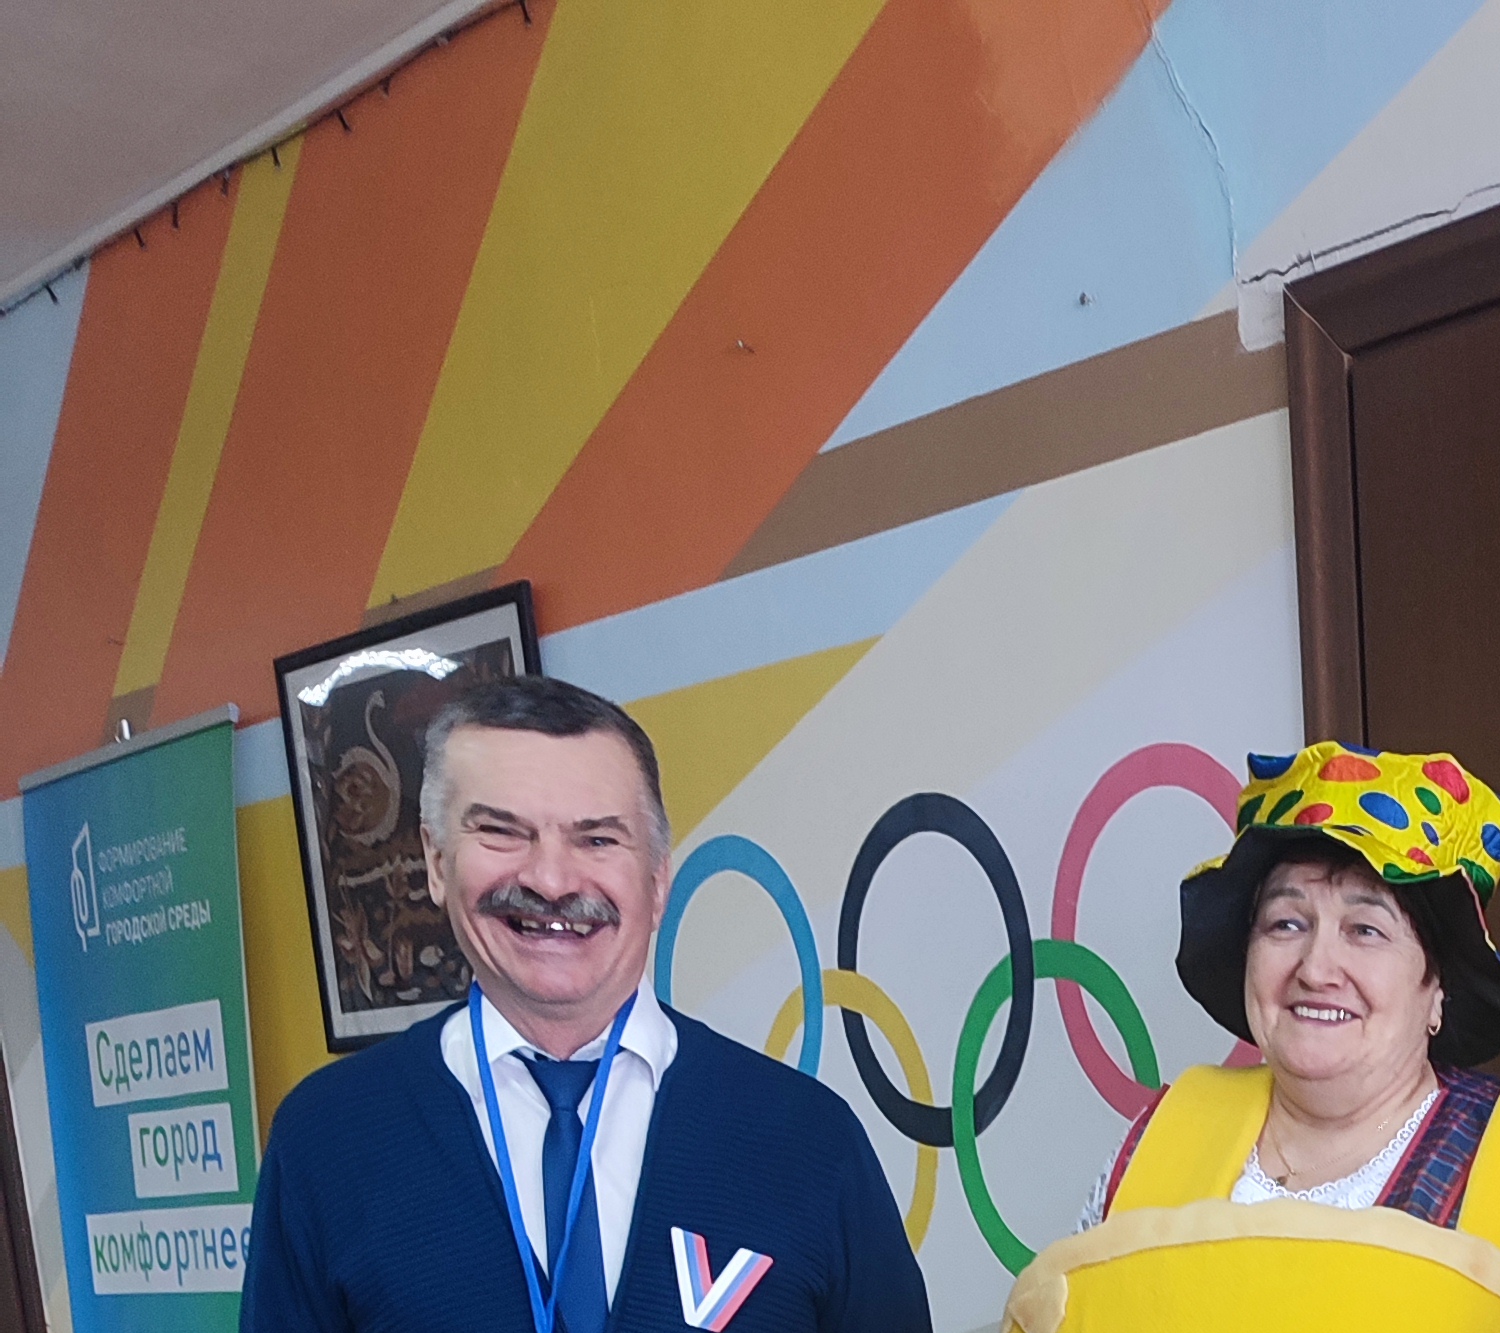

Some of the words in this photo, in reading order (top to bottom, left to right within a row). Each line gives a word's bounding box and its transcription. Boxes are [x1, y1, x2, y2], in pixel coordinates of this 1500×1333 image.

[106, 905, 167, 946] ГОРОДСКОЙ
[168, 899, 212, 931] СРЕДЫ
[95, 1027, 215, 1094] Сделаем
[139, 1119, 223, 1182] город
